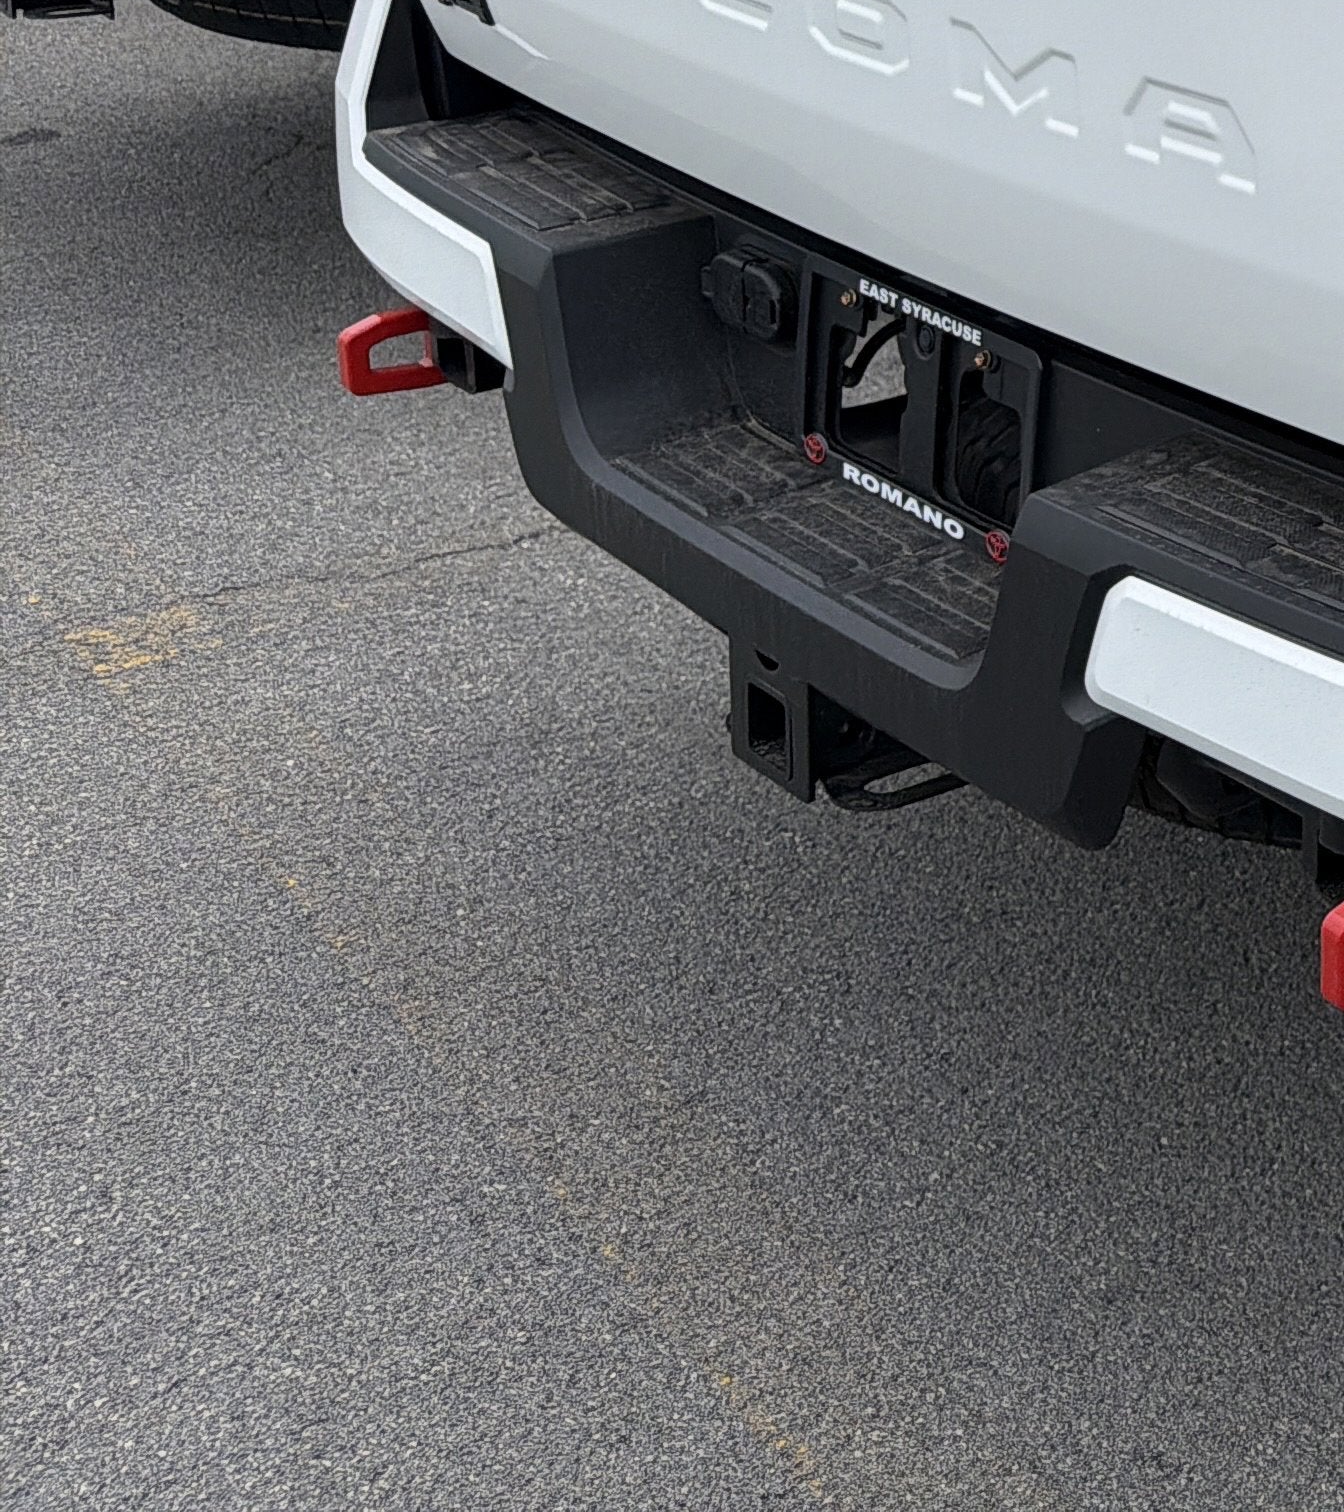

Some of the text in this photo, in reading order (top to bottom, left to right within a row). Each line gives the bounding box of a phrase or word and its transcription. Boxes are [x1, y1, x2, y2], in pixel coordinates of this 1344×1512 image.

[860, 278, 982, 346] EAST SYRACUSE
[843, 461, 965, 540] ROMANO
